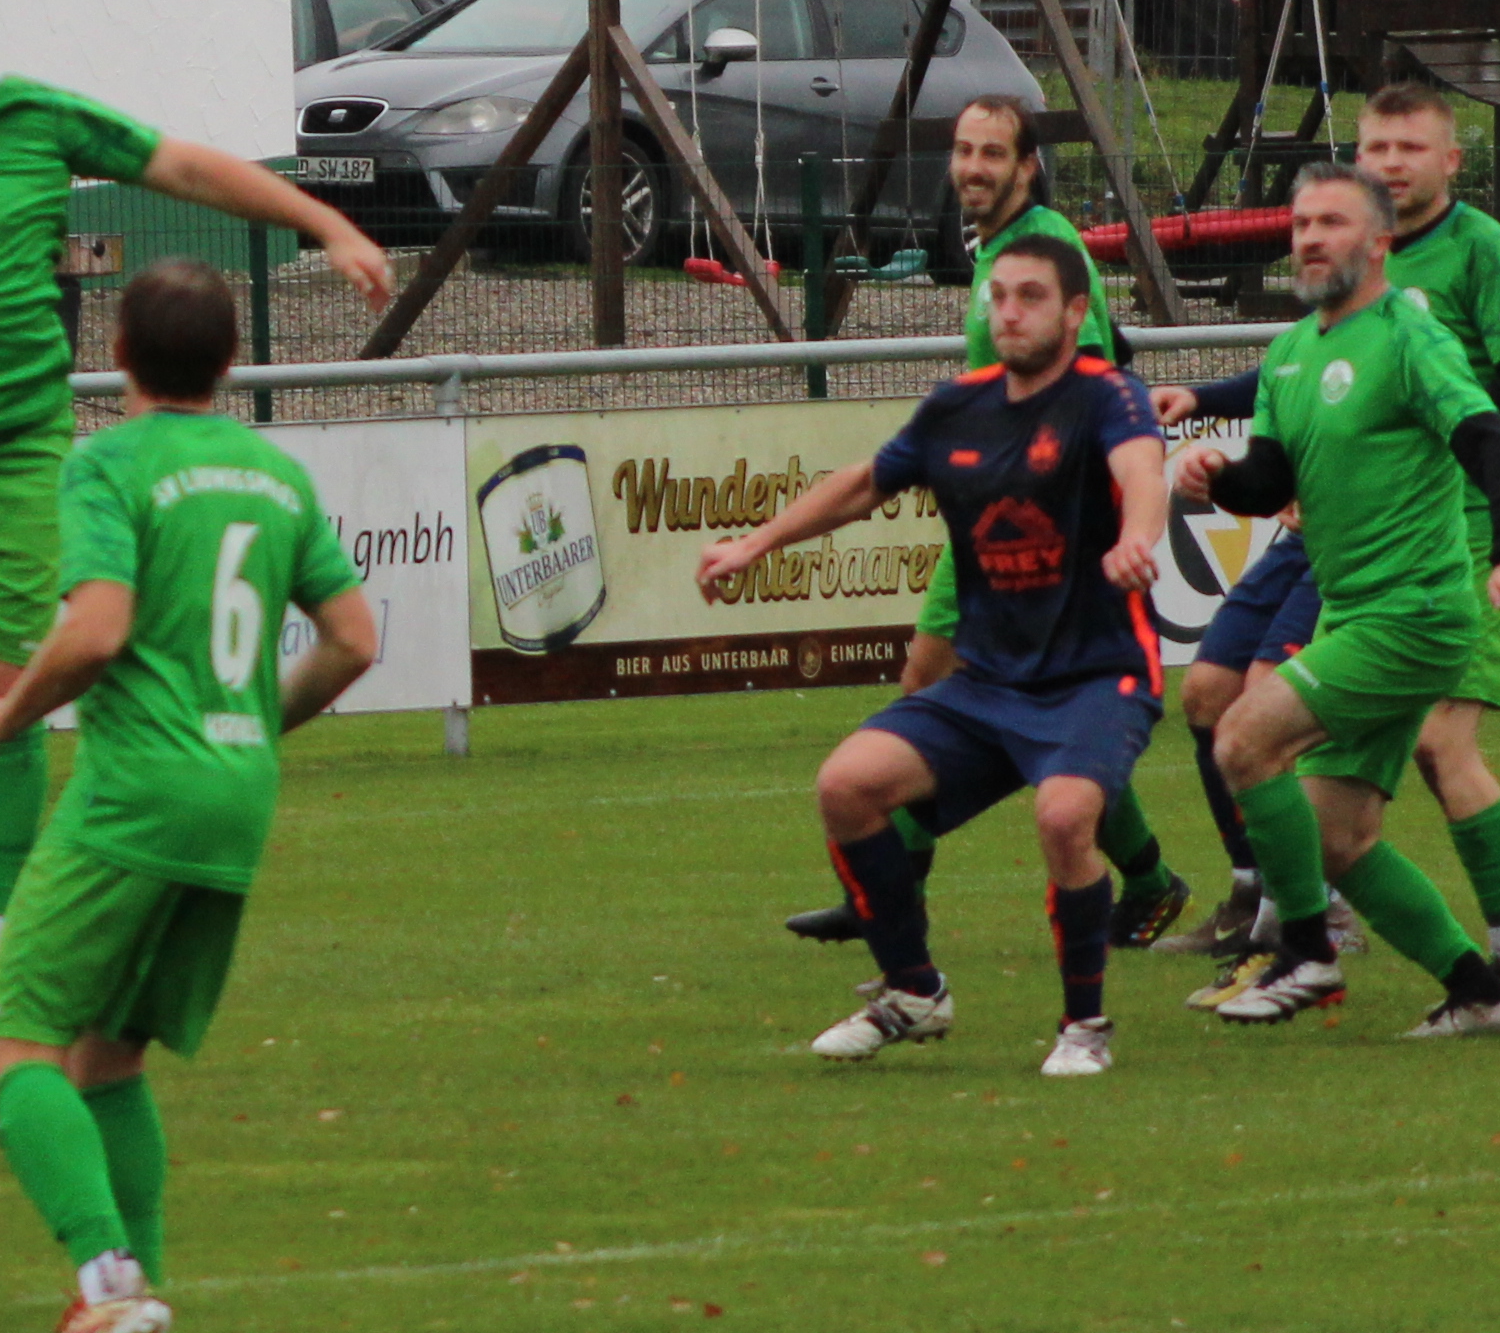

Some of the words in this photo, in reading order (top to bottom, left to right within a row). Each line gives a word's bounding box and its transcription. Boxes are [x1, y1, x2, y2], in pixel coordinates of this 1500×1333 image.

[341, 160, 371, 180] 187
[354, 509, 454, 582] gmbh
[496, 535, 596, 606] UNTERBAARER
[211, 521, 263, 693] 6
[616, 656, 651, 676] BIER
[662, 654, 692, 673] AUS
[701, 648, 790, 672] UNTERBAAR
[831, 642, 894, 663] EINFACH
